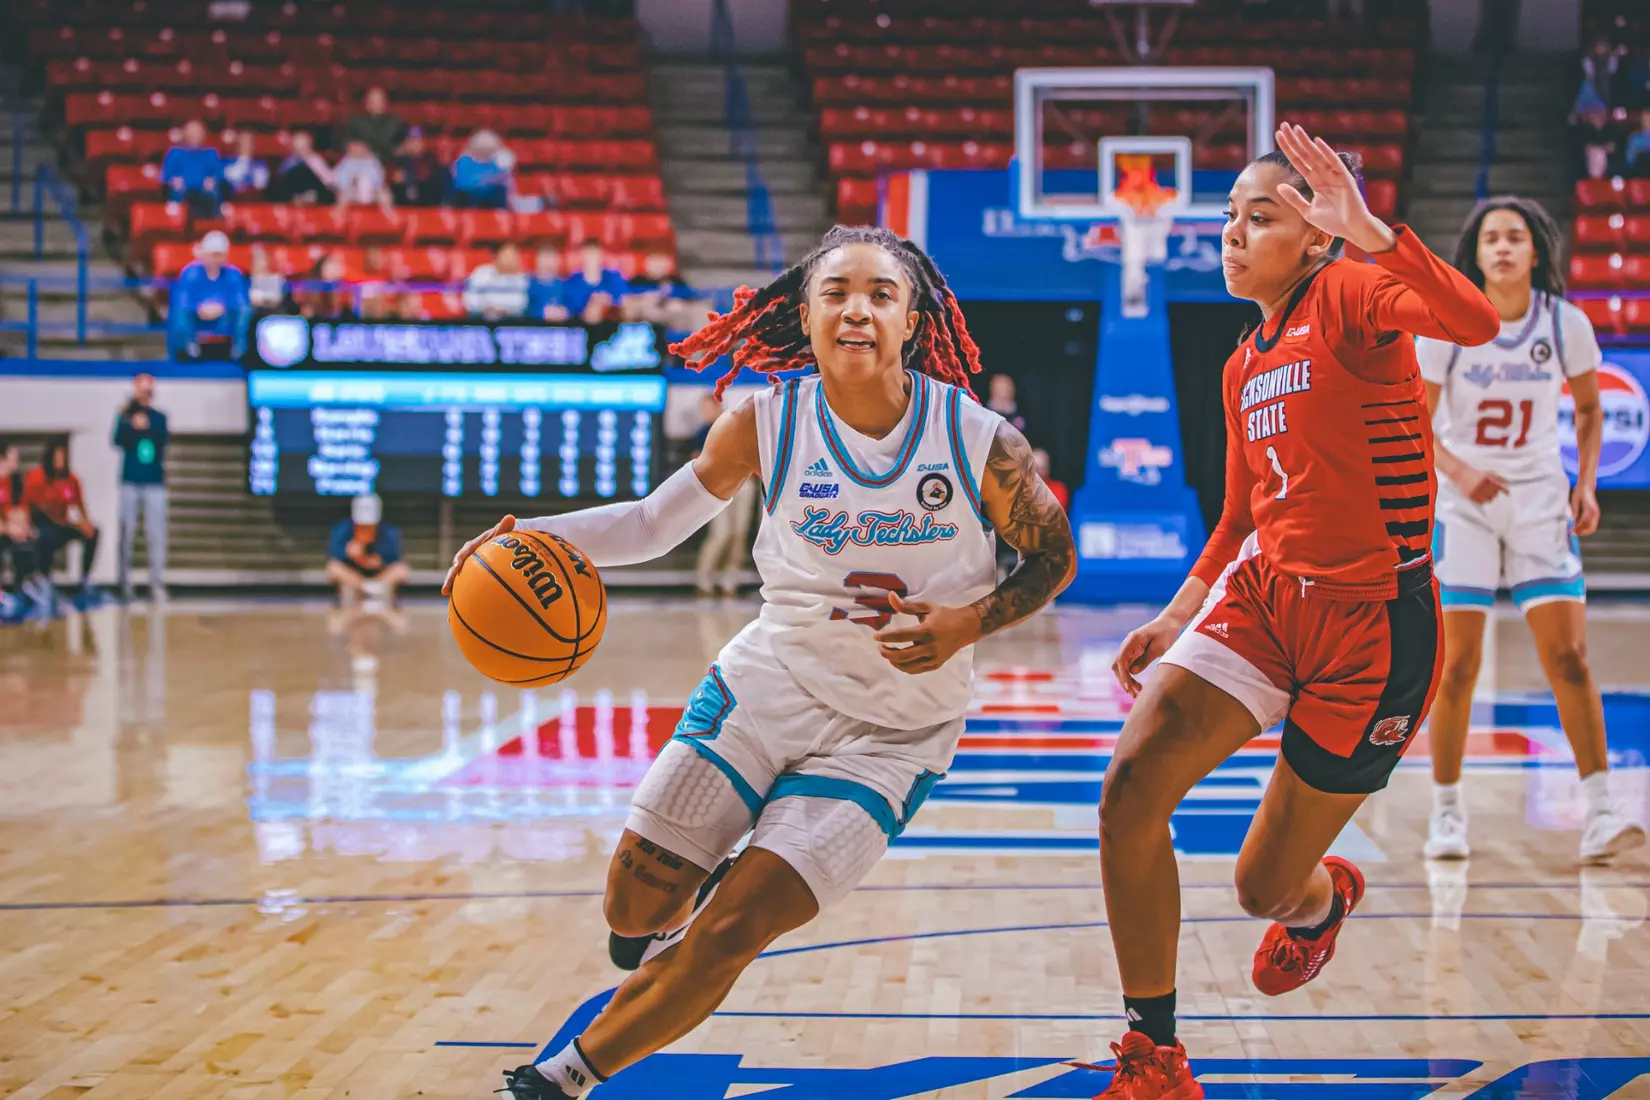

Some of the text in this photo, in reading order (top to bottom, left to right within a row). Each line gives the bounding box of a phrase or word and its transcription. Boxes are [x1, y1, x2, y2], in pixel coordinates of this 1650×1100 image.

[1240, 359, 1312, 413] CKSONVILLE
[1247, 401, 1288, 443] STATE
[1475, 399, 1534, 449] 21
[804, 469, 833, 478] adidas
[1265, 444, 1289, 500] 1
[790, 505, 959, 556] Lady Techsters
[491, 533, 563, 610] Wilson
